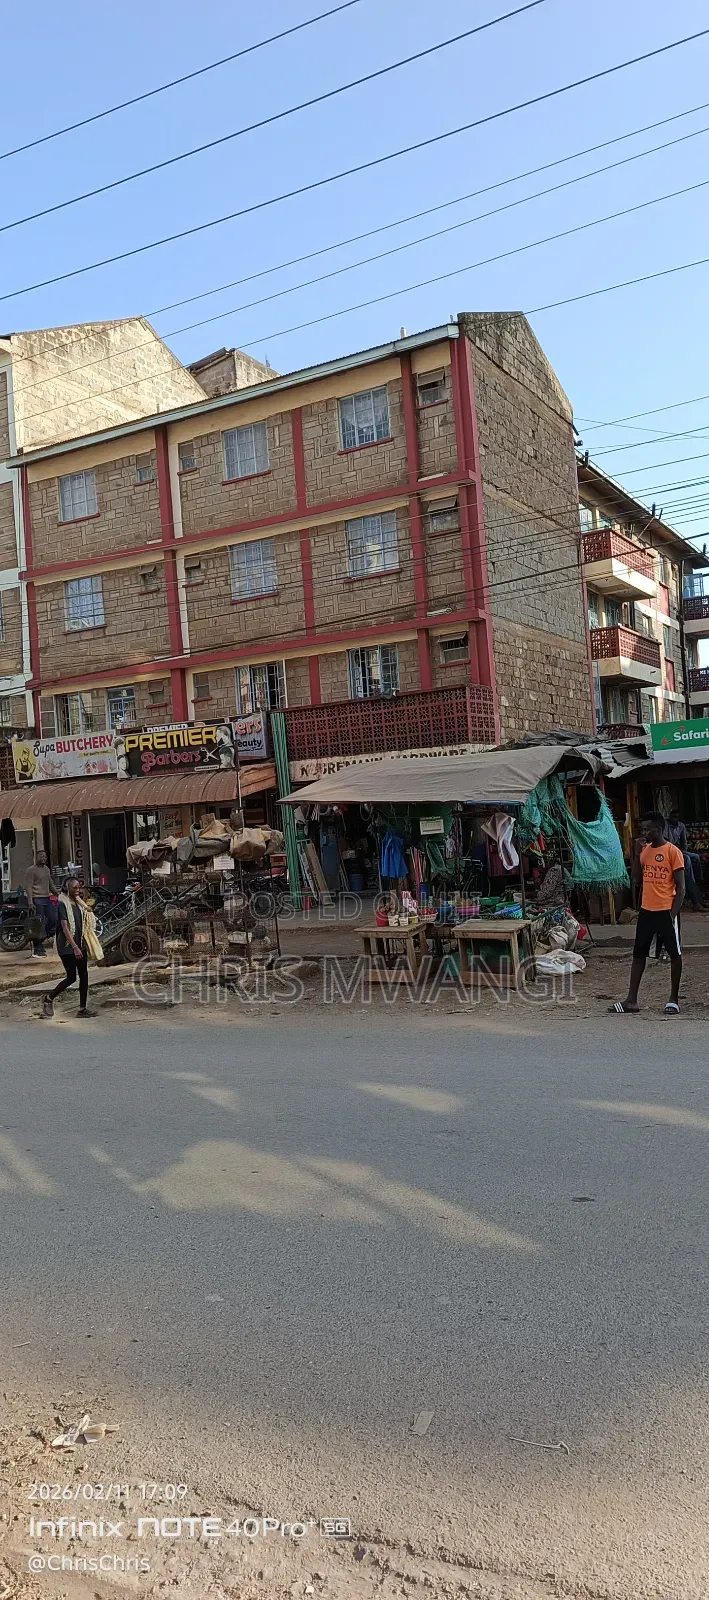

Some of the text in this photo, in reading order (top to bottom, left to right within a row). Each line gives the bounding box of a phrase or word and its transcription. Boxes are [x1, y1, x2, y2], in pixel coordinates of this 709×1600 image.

[236, 719, 262, 735] ers
[673, 728, 709, 742] Safari
[33, 740, 56, 758] Supa
[56, 734, 113, 754] BUTCHERY
[125, 726, 217, 752] PREMIER
[141, 750, 201, 772] Barbers
